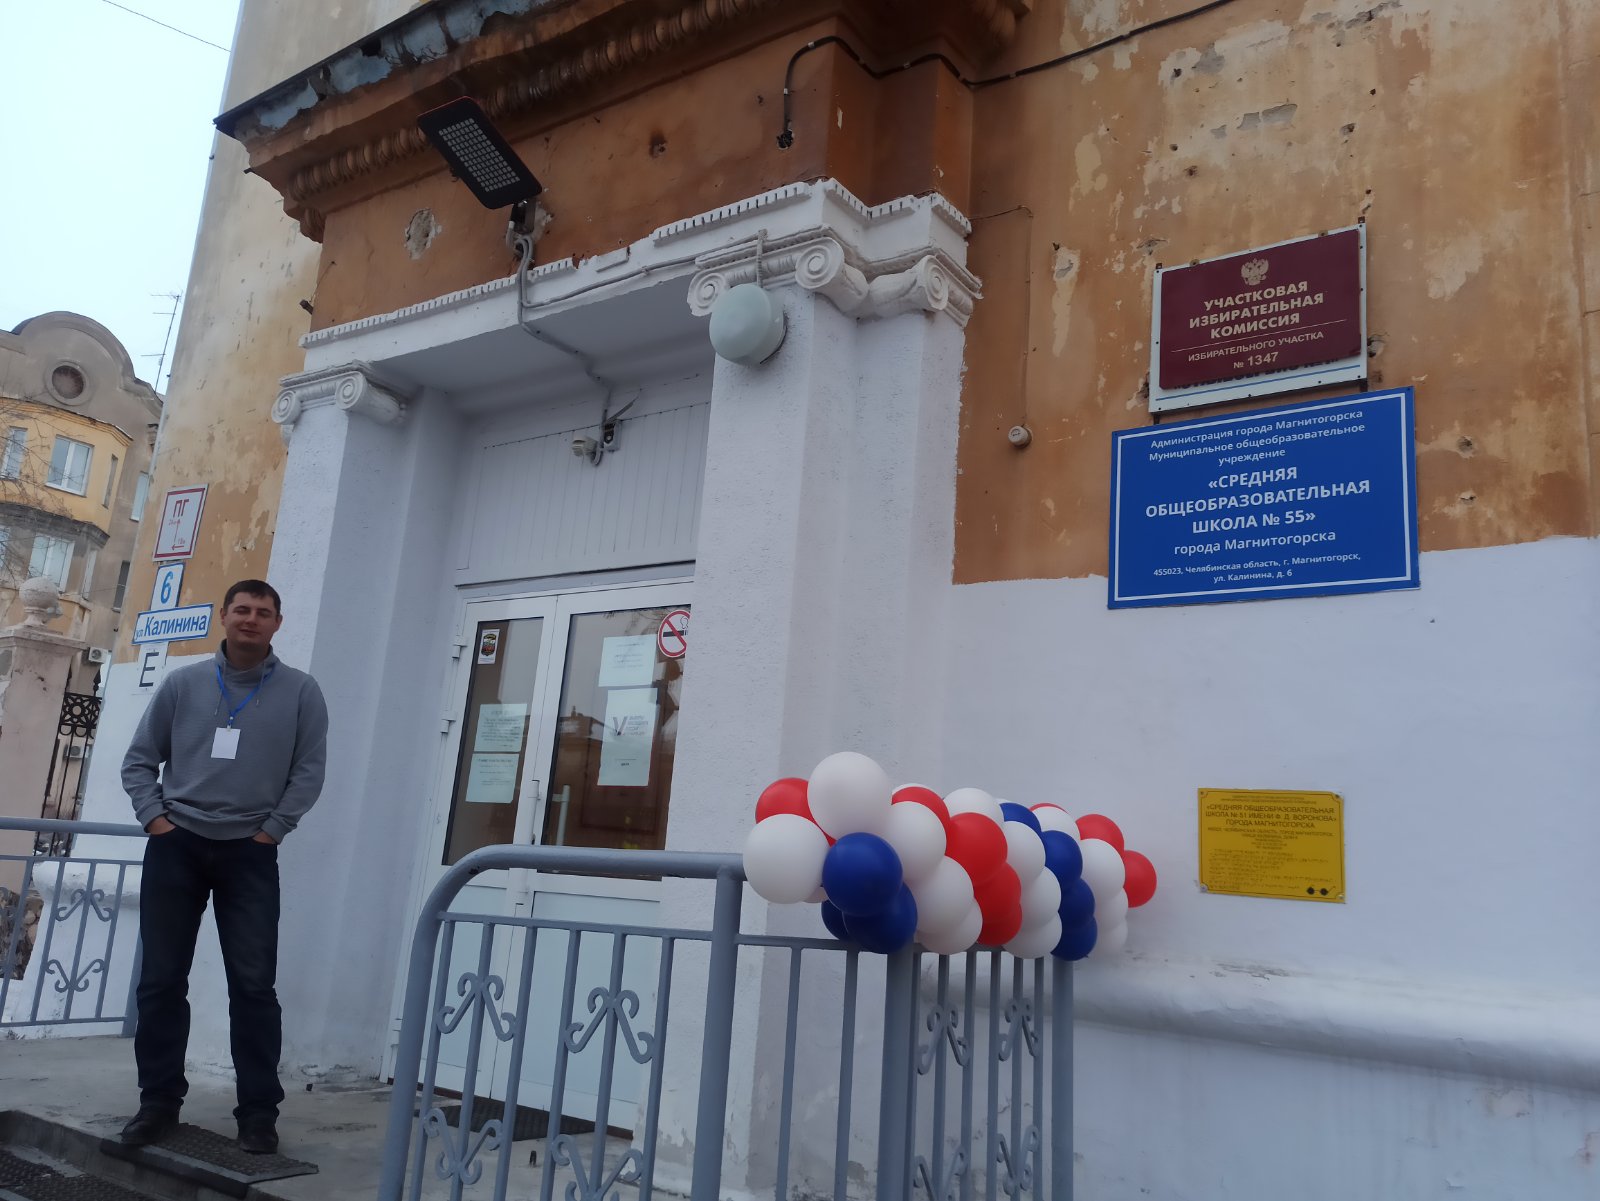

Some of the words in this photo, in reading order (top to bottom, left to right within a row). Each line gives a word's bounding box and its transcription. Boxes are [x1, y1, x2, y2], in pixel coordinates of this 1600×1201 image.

[1204, 281, 1308, 311] УЧАСТКОВАЯ
[1189, 292, 1324, 329] ИЗБИРАТЕЛЬНАЯ
[1210, 312, 1300, 339] КОМИССИЯ
[1188, 339, 1276, 362] ИЗБИРАТЕЛЬНОГО
[1278, 331, 1324, 346] УЧАСТКА
[1233, 361, 1244, 369] №
[1248, 351, 1279, 367] 1347
[1149, 443, 1233, 462] Муниципальное
[1236, 424, 1365, 449] общеобразовательное
[1151, 430, 1233, 449] Администрация
[1236, 424, 1273, 437] города
[1275, 410, 1363, 430] Магнитогорска
[1218, 449, 1286, 467] учреждение
[1208, 466, 1298, 490] «СРЕДНЯЯ
[173, 499, 190, 518] ПГ
[1145, 479, 1371, 518] ОБЩЕОБРАЗОВАТЕЛЬНАЯ
[1192, 515, 1257, 534] ШКОЛА
[1262, 513, 1280, 526] №
[1285, 510, 1316, 525] 55»
[1174, 540, 1221, 557] города
[1225, 530, 1336, 551] Магнитогорска
[1153, 568, 1183, 576] 455023,
[1185, 563, 1241, 574] Челябинская
[1243, 560, 1281, 569] область,
[1292, 553, 1361, 565] Магнитогорск,
[1213, 576, 1226, 584] ул.
[1228, 571, 1274, 581] Калинина,
[1276, 571, 1285, 579] д.
[1286, 569, 1293, 577] 6
[161, 571, 174, 605] 6
[144, 615, 208, 636] Калинина
